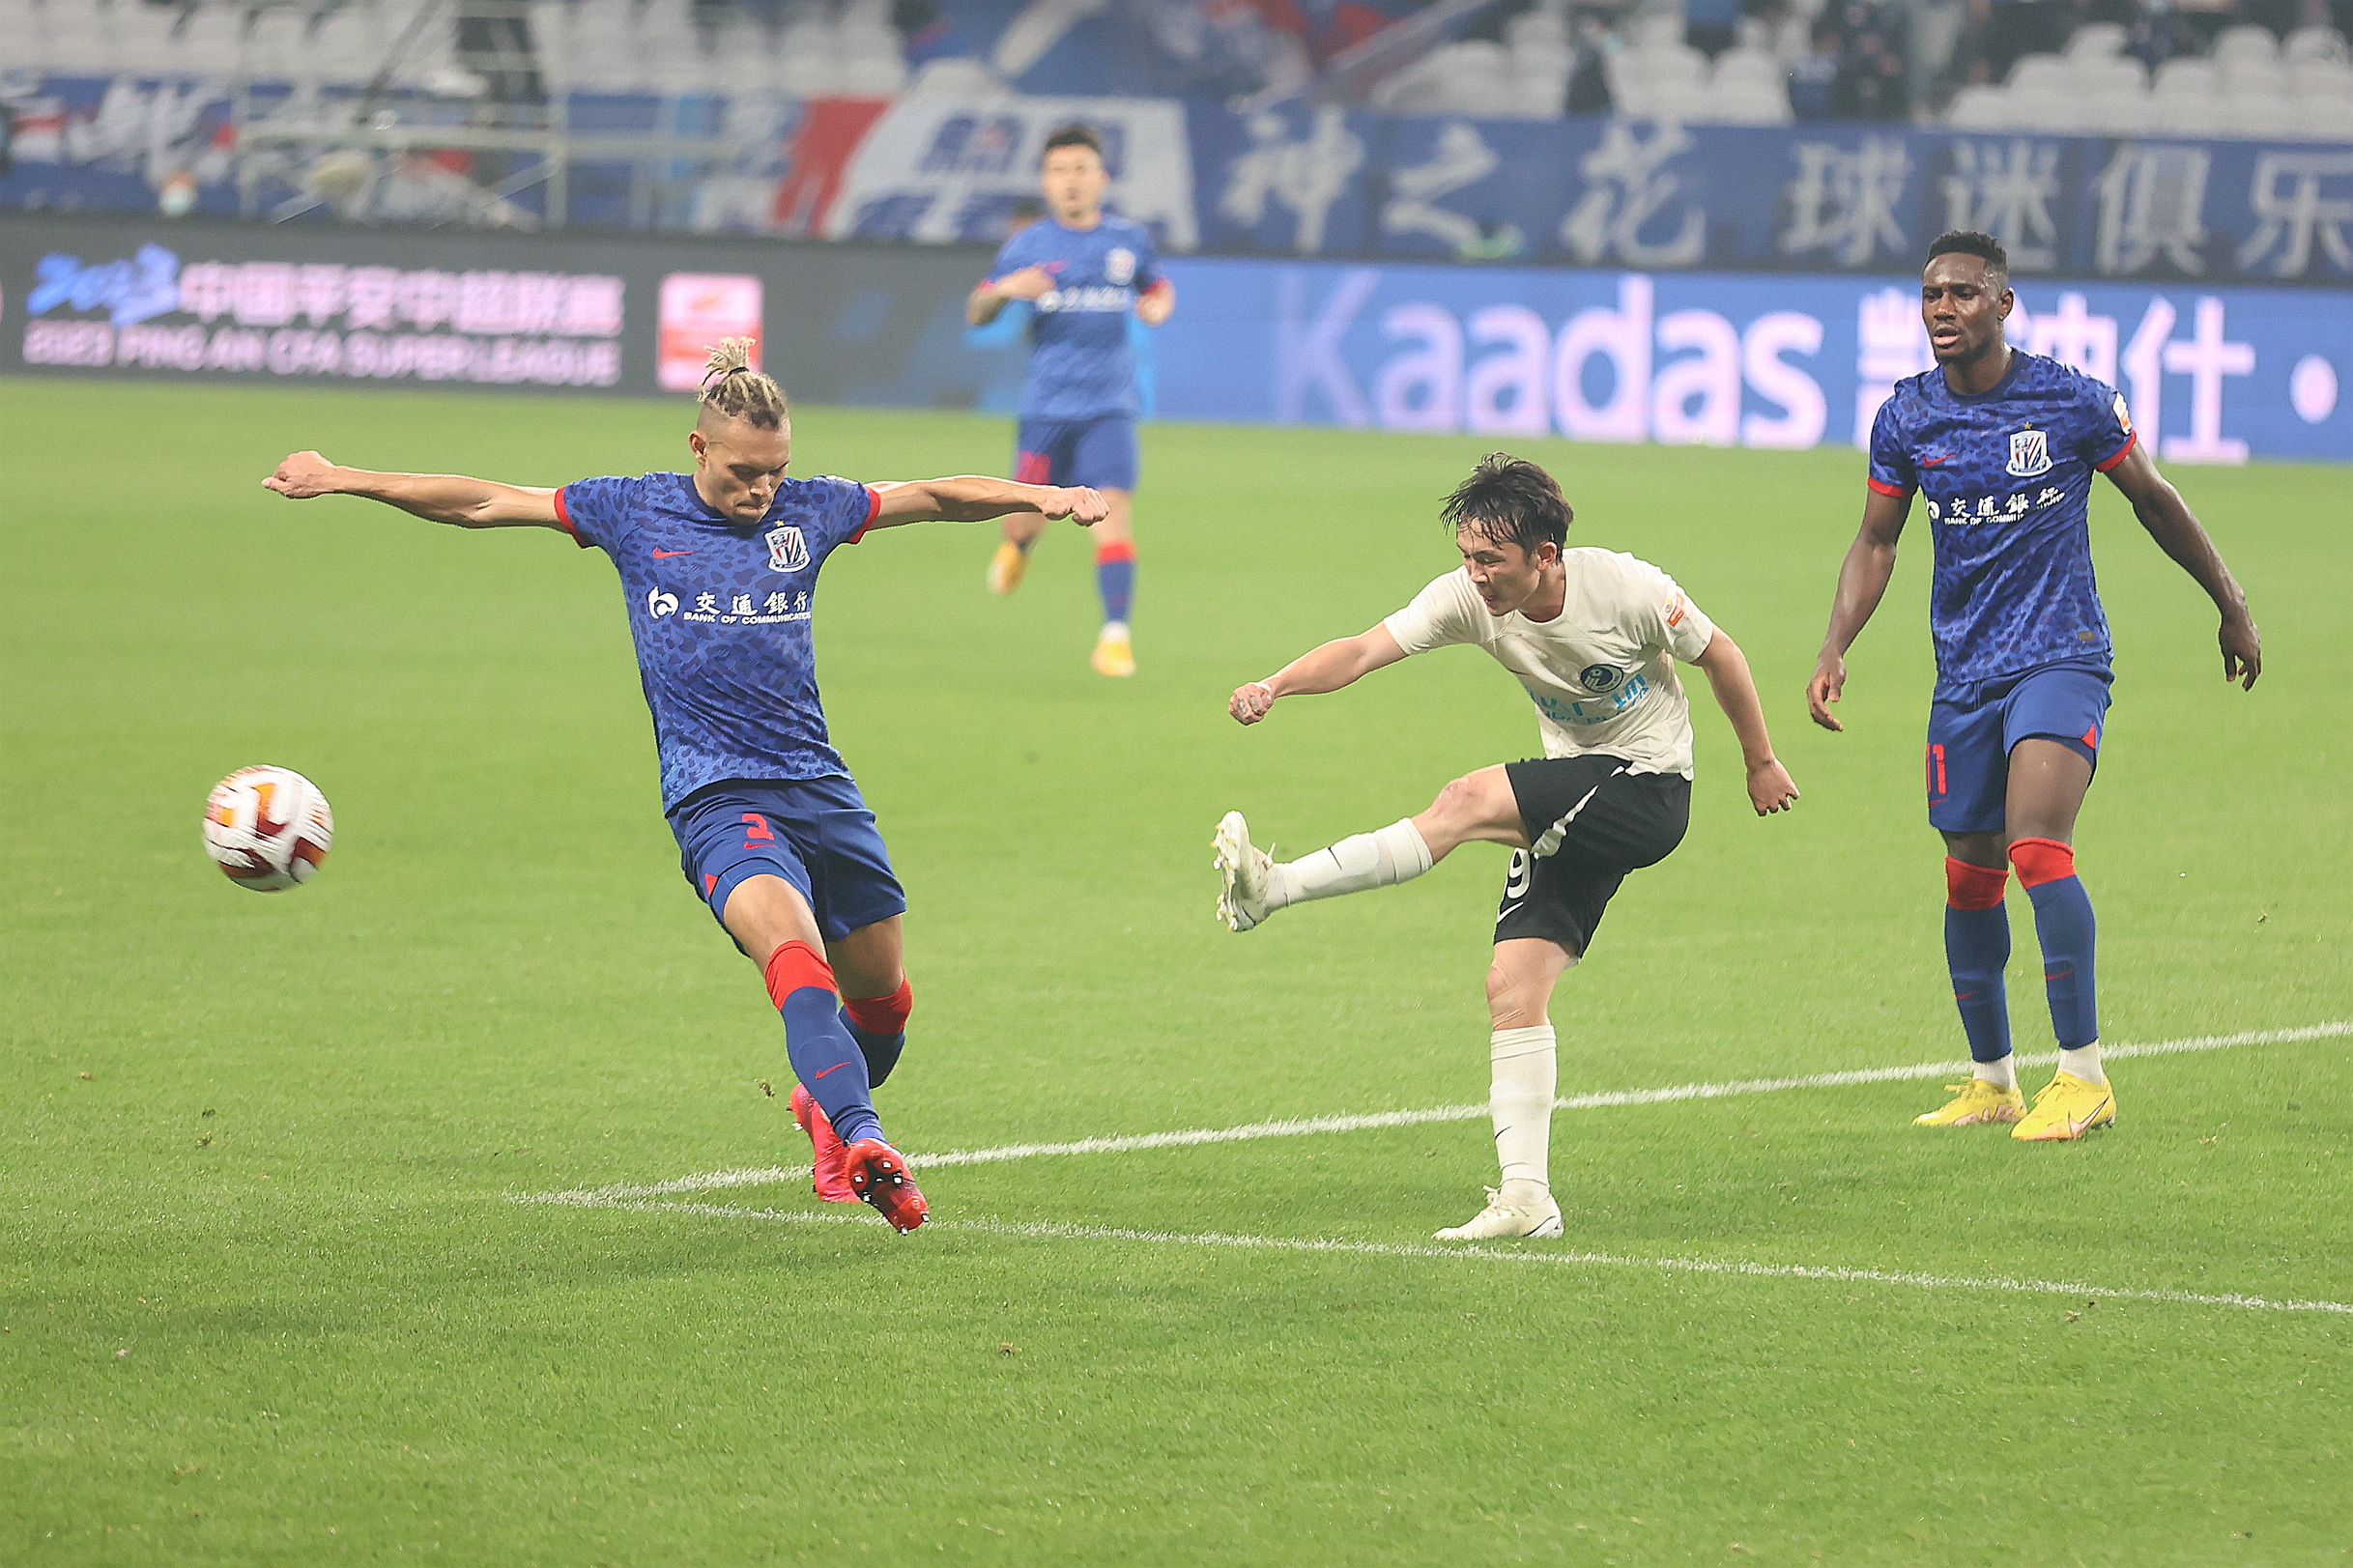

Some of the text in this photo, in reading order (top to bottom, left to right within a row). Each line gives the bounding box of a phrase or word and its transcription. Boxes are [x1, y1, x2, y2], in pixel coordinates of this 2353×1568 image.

[1272, 271, 1829, 451] Kaadas
[683, 612, 717, 623] BANK
[721, 615, 738, 625] OF
[694, 590, 809, 616] 交通銀行
[1506, 846, 1531, 898] 9
